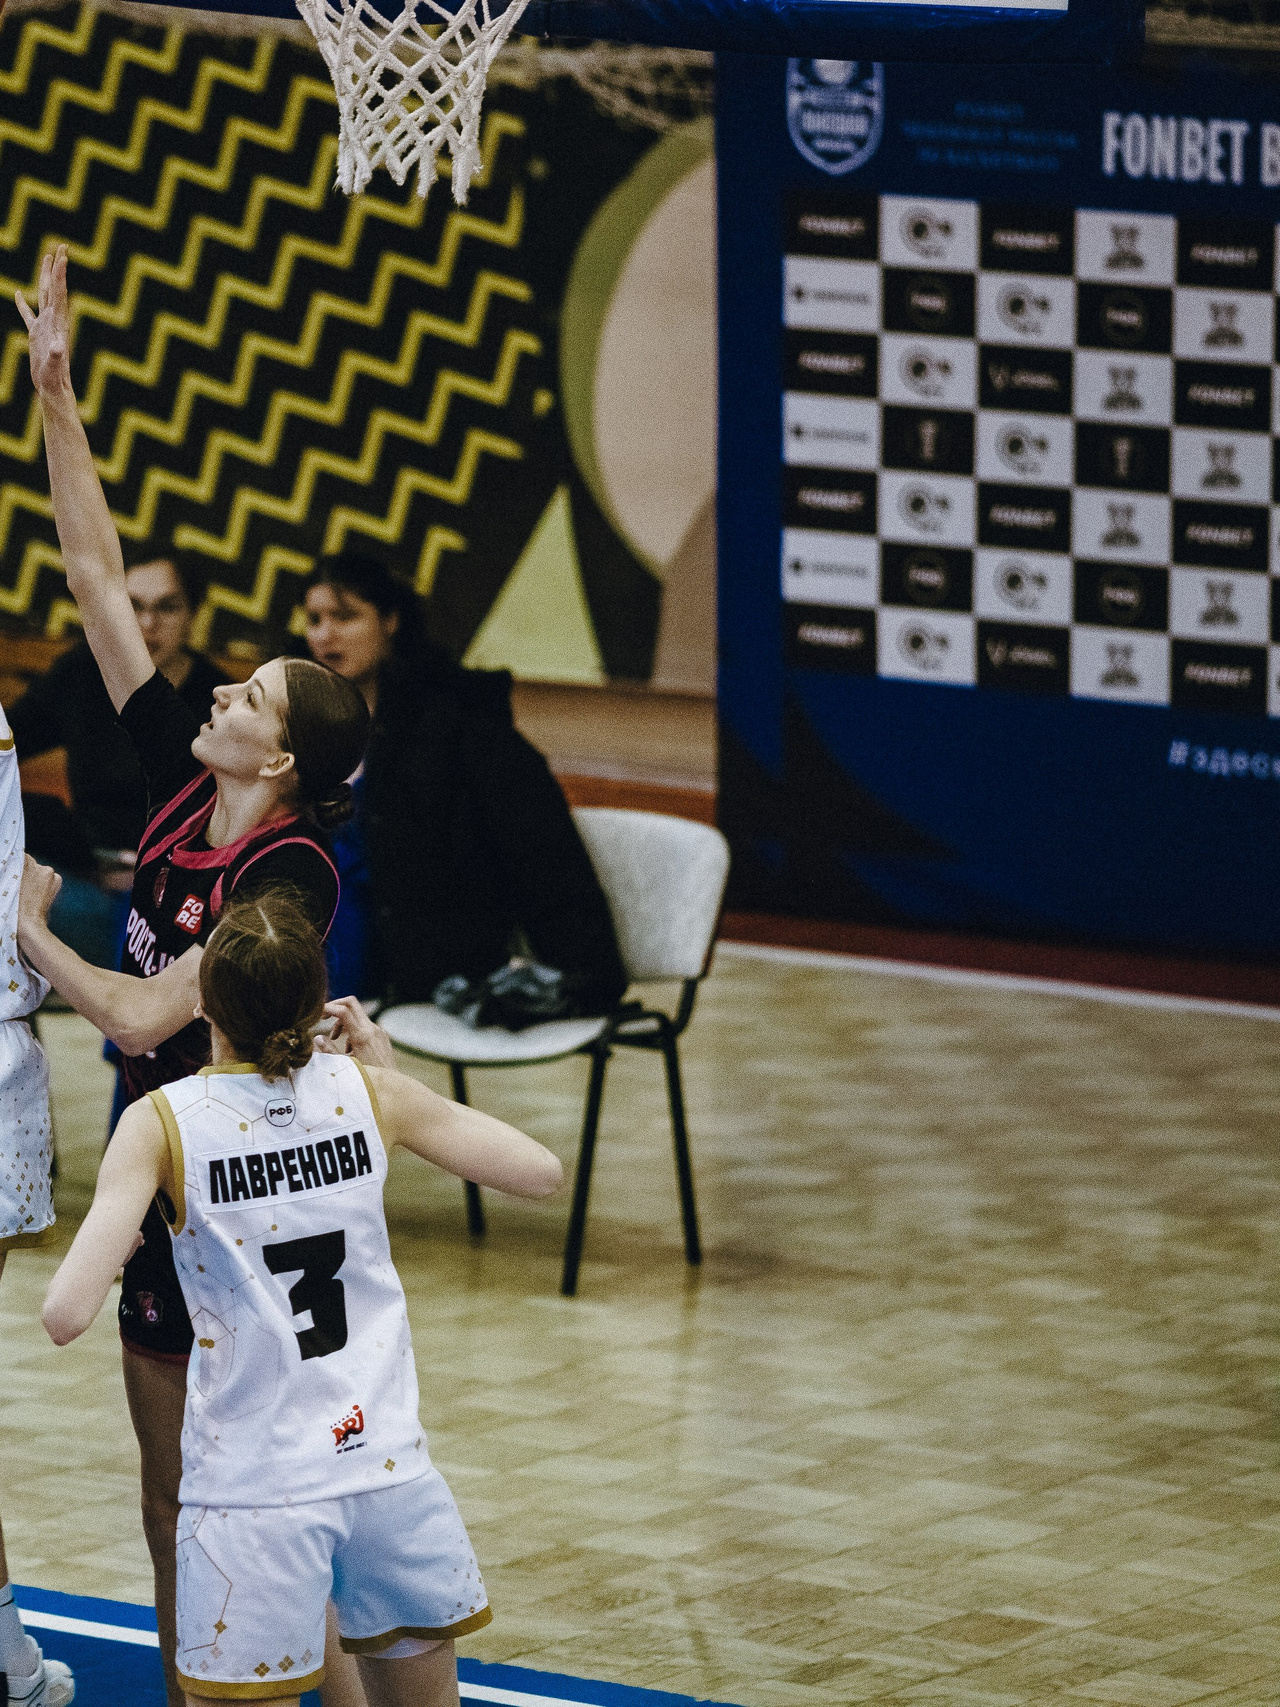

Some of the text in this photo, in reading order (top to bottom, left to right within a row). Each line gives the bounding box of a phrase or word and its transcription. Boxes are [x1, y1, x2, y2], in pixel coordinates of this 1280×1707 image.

[1102, 111, 1251, 185] FONBET
[182, 898, 205, 915] FO
[176, 909, 200, 929] BE
[269, 1105, 293, 1117] РФБ
[262, 1229, 348, 1361] 3
